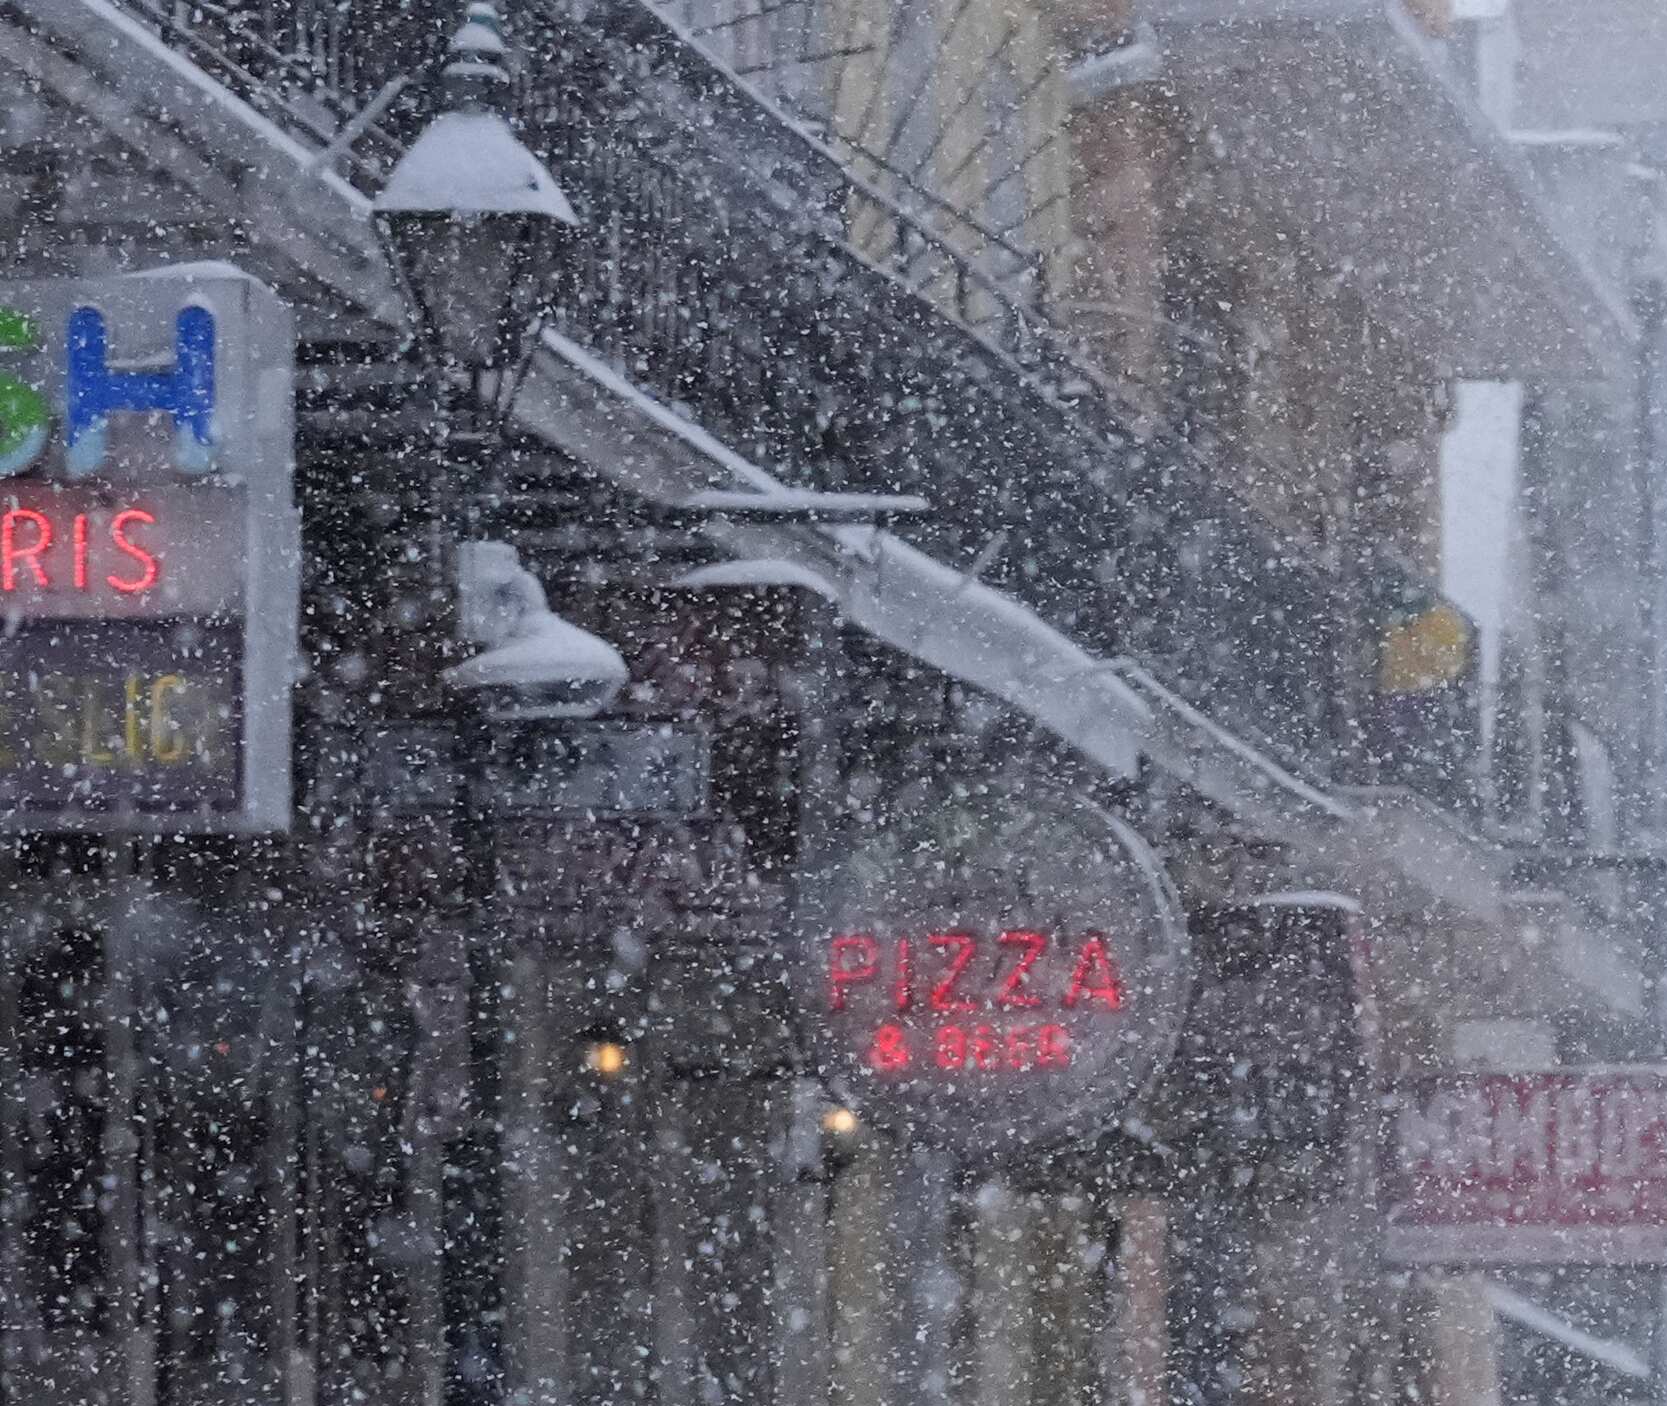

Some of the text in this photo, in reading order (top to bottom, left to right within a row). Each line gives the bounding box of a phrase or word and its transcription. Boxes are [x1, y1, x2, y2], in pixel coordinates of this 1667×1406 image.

[0, 507, 160, 592] RIS
[829, 931, 1123, 1010] PIZZA
[868, 1023, 911, 1071] &
